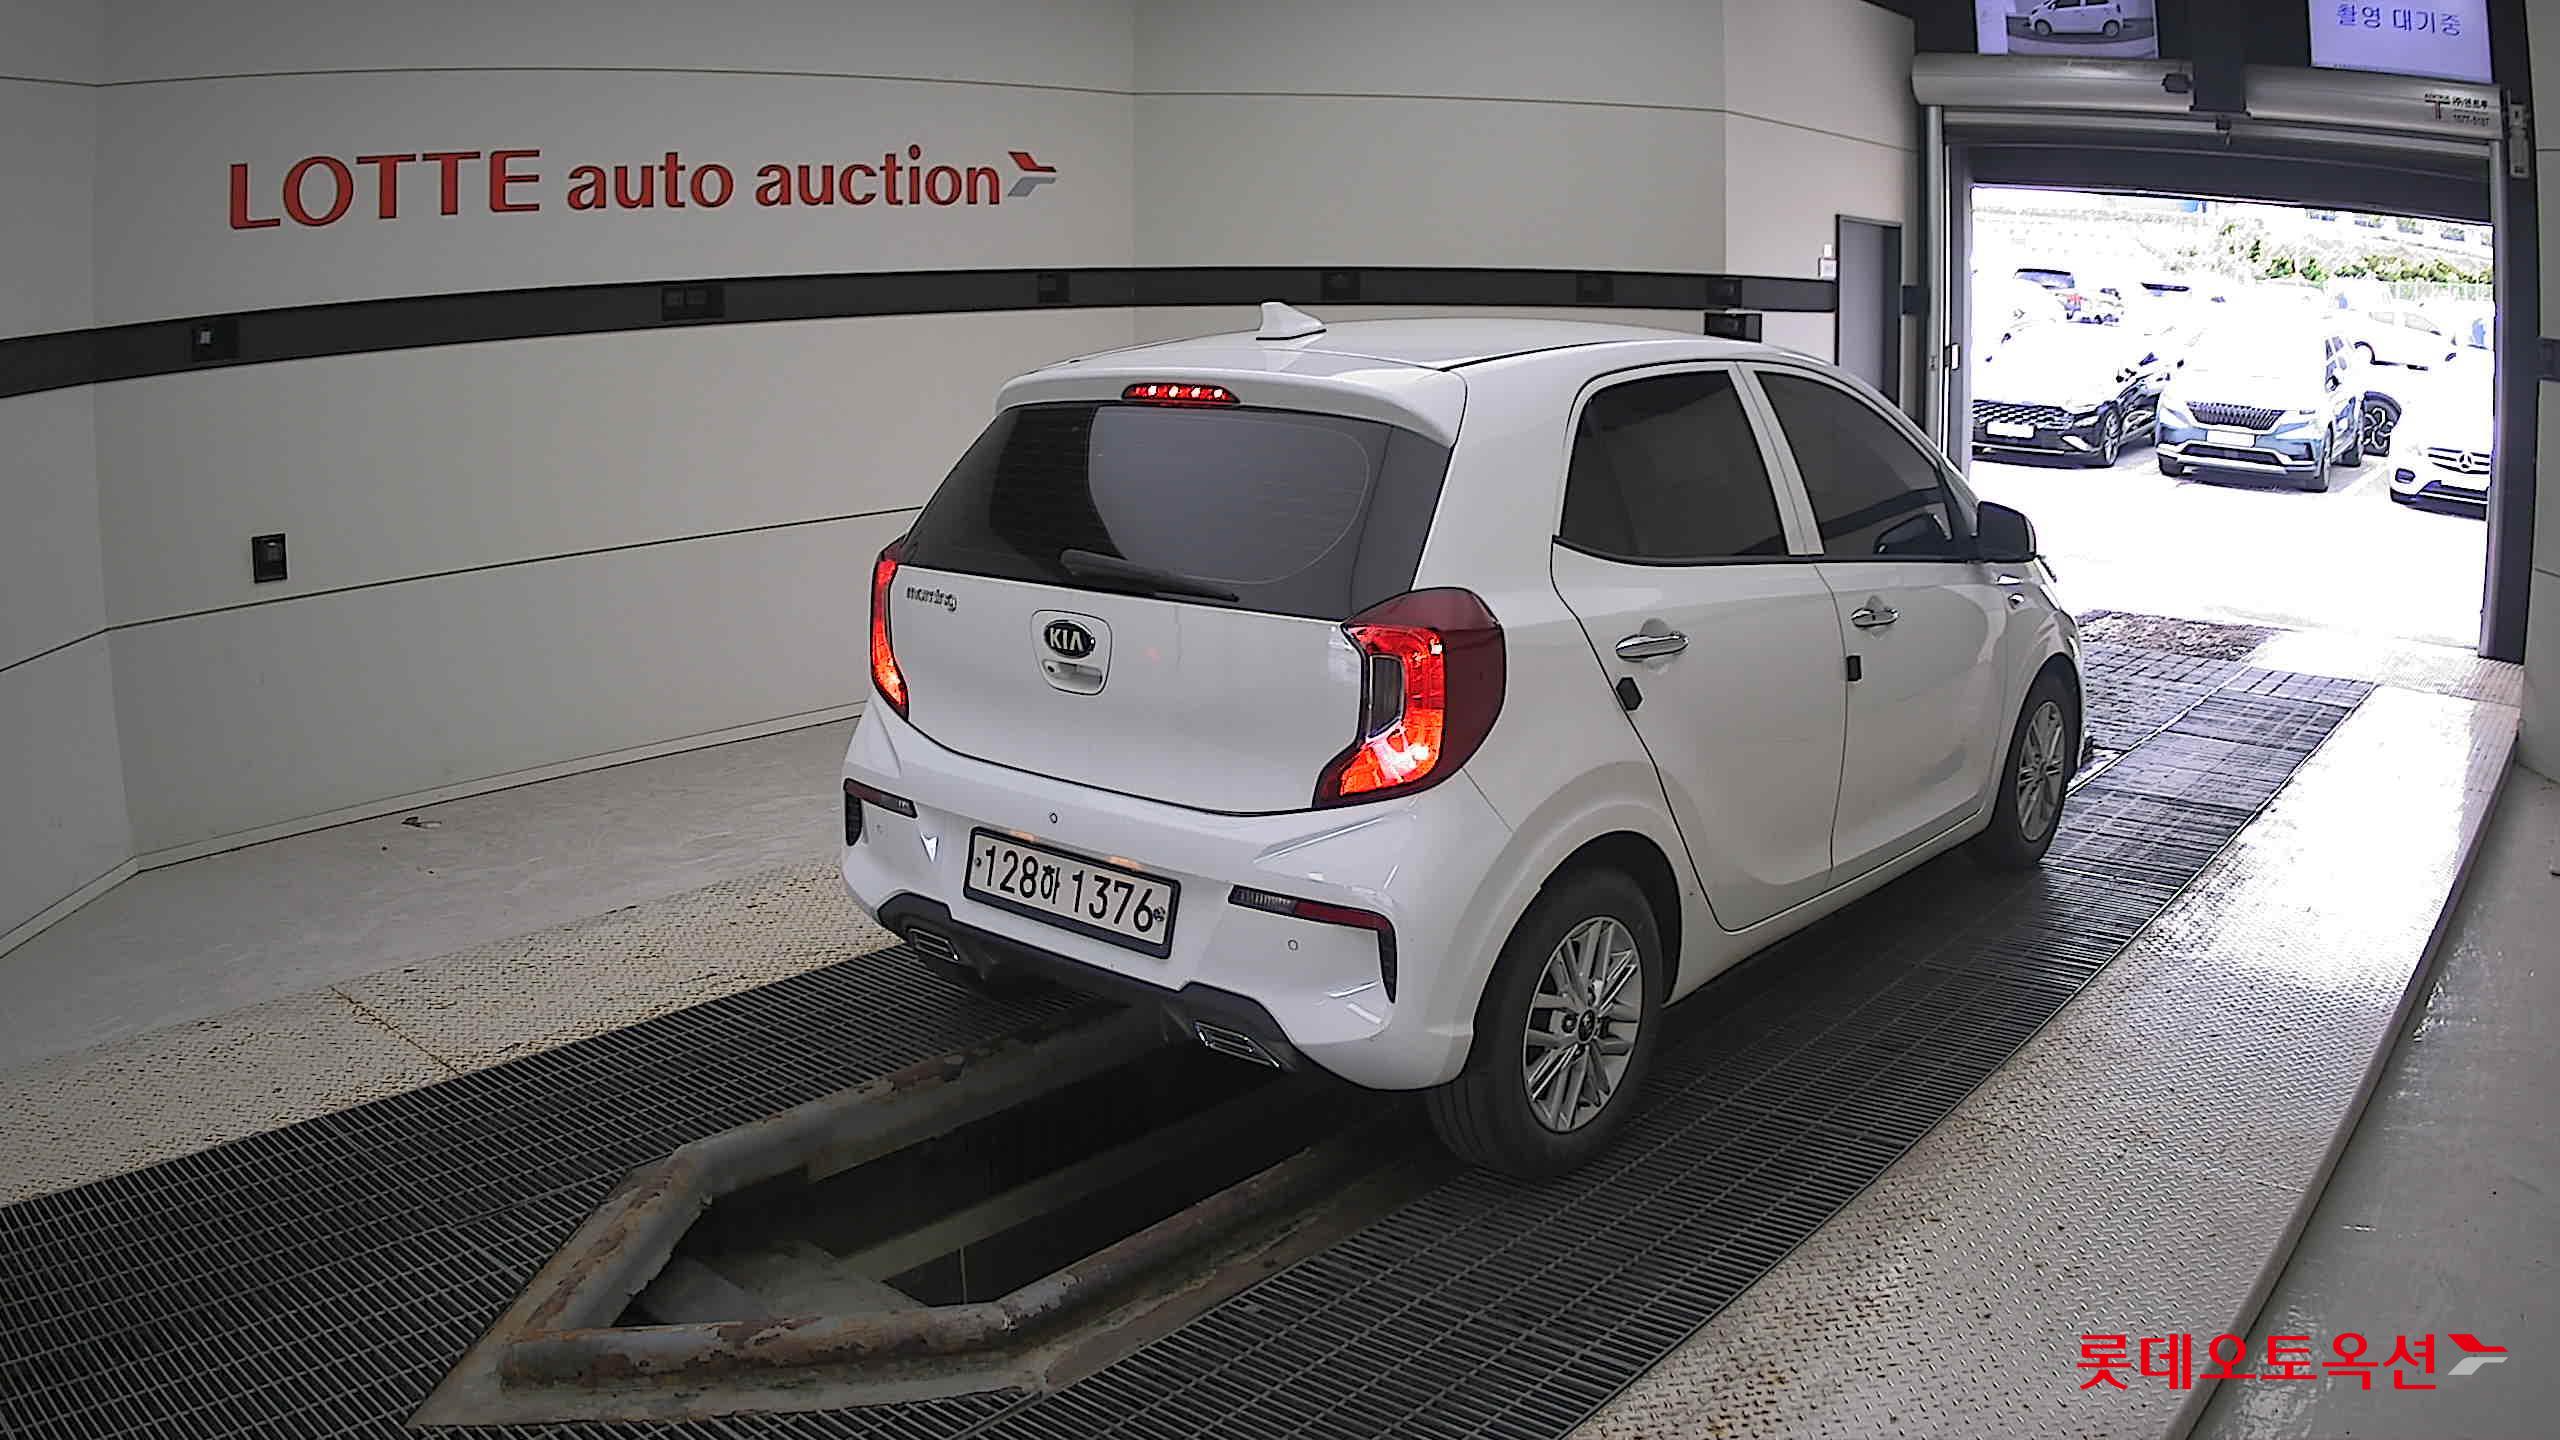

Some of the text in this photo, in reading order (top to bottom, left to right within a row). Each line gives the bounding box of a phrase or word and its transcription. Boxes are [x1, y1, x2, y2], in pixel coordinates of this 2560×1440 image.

[2337, 3, 2462, 37] 촬영 대기중
[229, 144, 1001, 230] LOTTE auto auction
[1049, 627, 1085, 652] KIA
[985, 845, 1154, 933] 128하 1376
